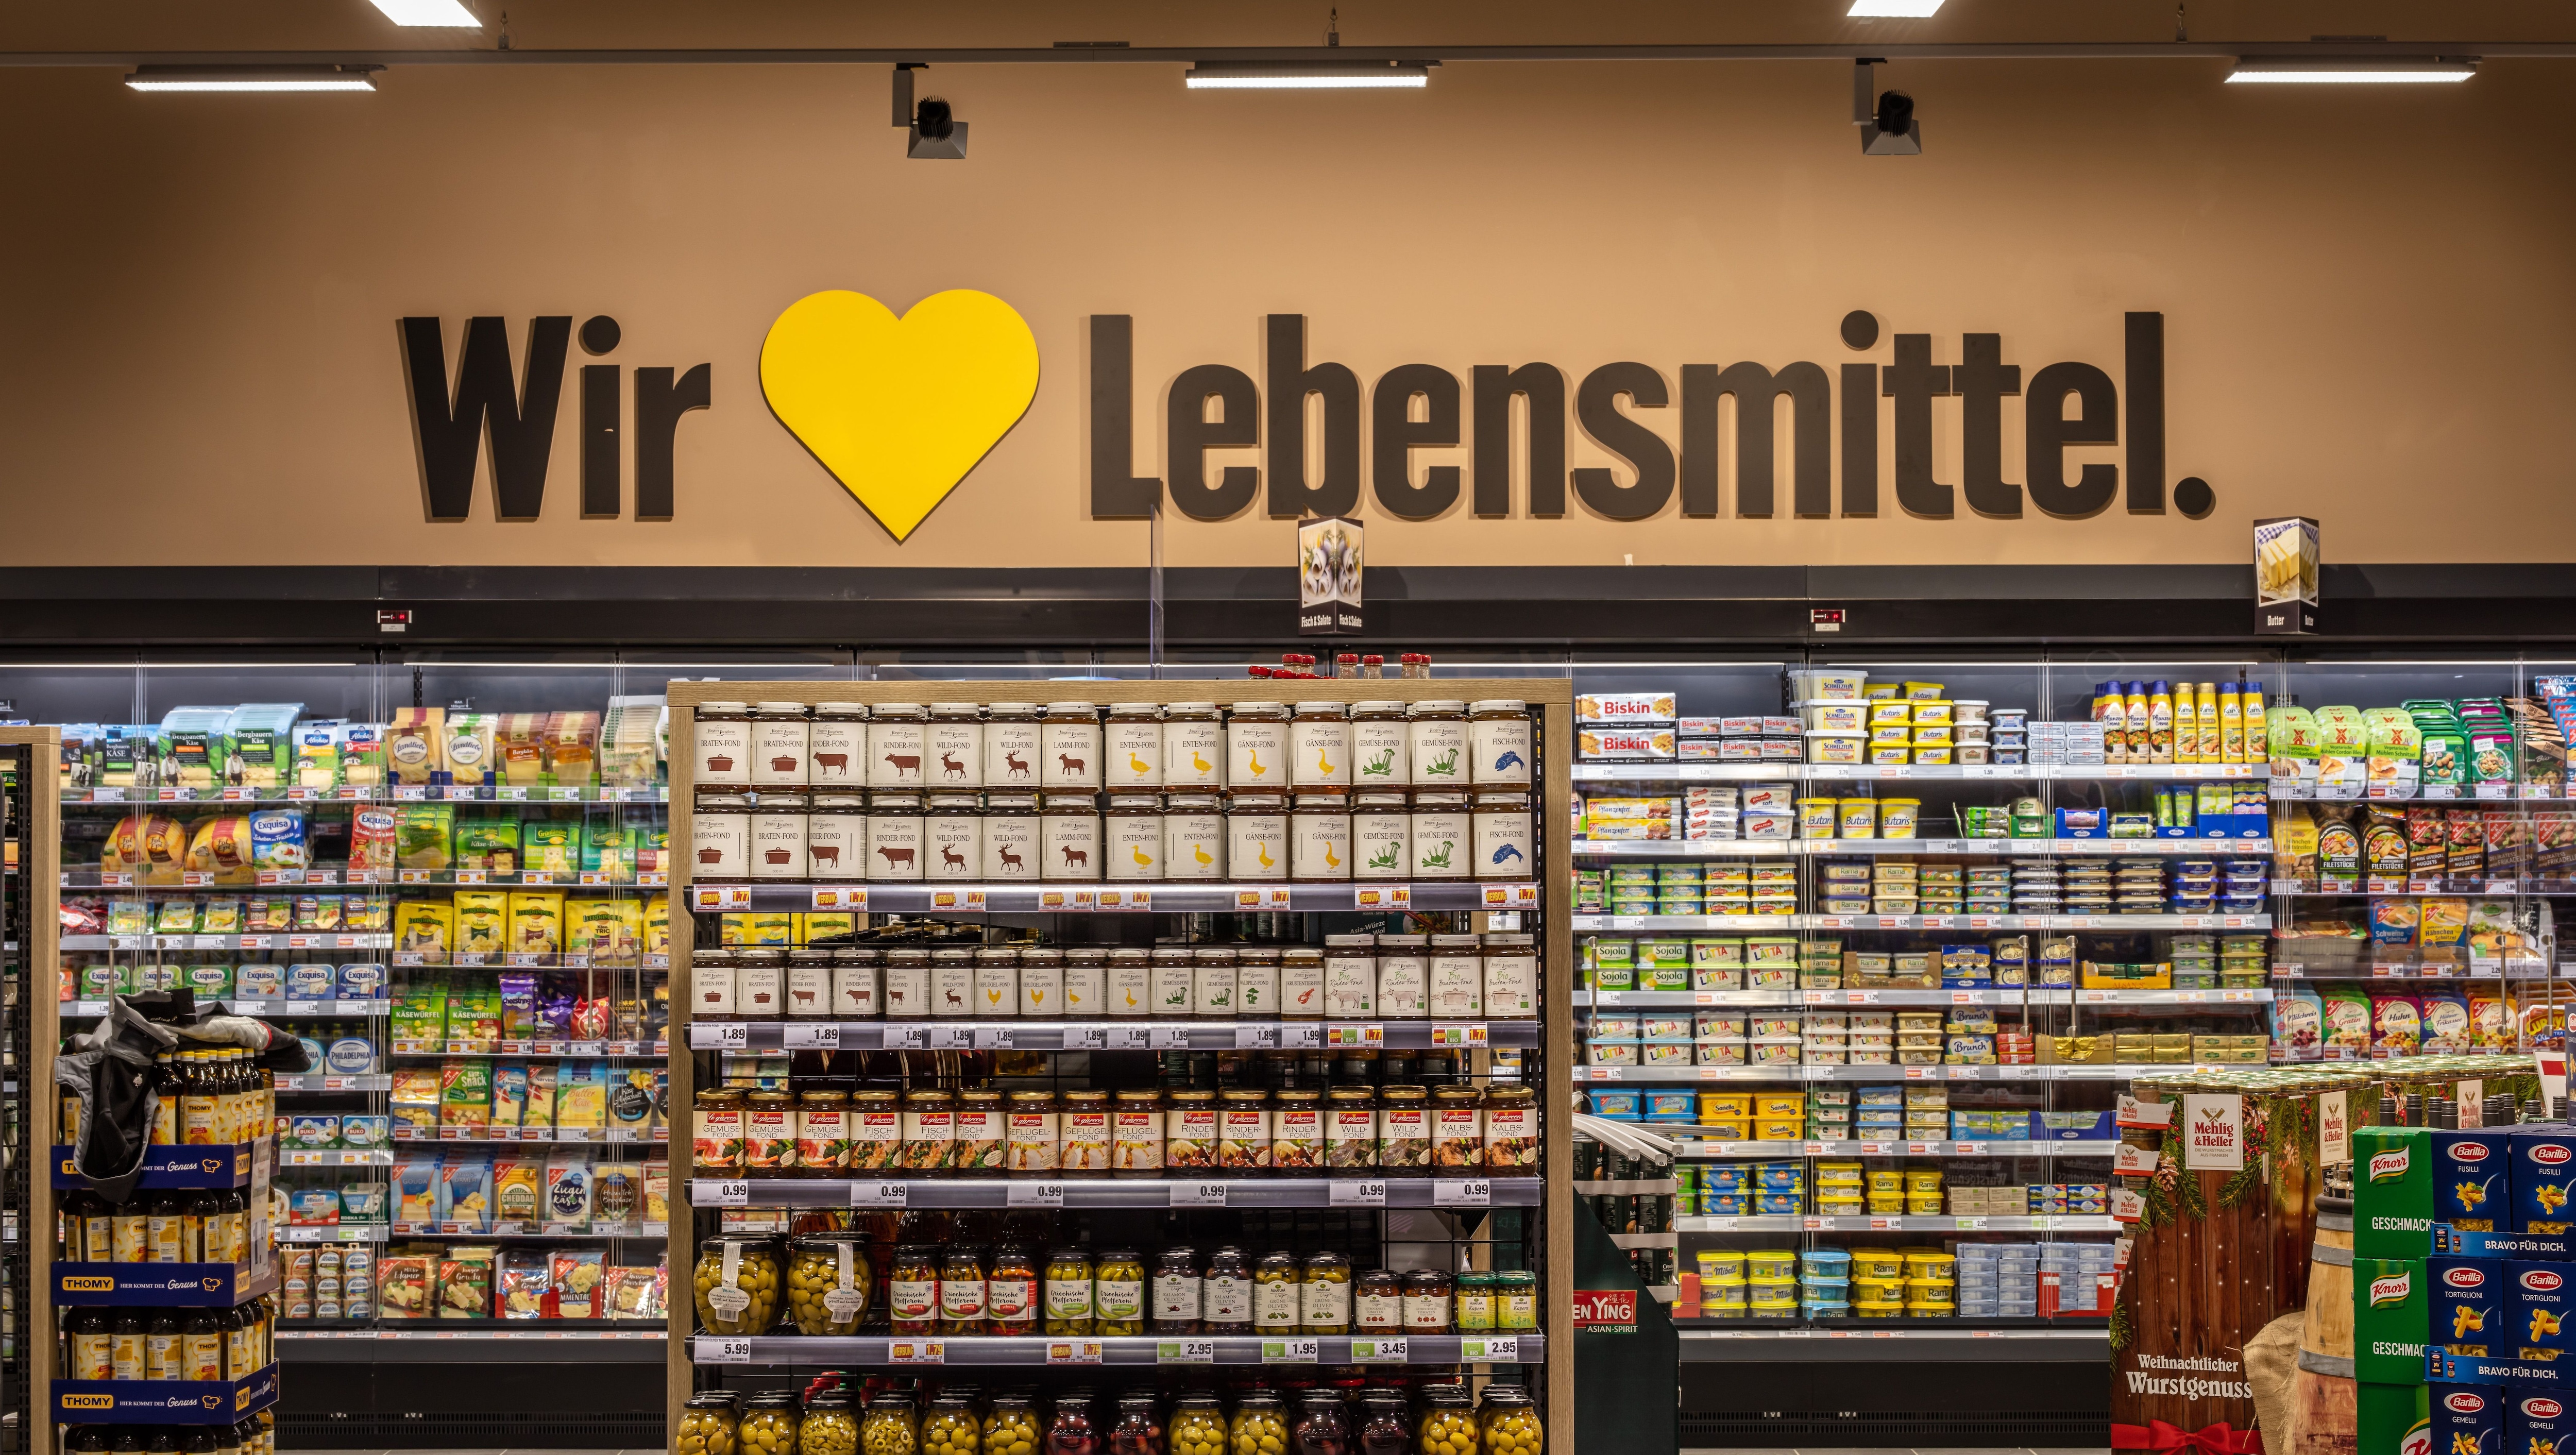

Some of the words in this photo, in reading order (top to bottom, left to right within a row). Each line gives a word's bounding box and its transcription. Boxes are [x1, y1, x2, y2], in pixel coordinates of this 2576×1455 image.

[401, 316, 714, 524] Wir
[1089, 311, 2215, 520] Lebensmittel.
[1301, 616, 1312, 627] Fisch
[1313, 616, 1317, 627] &
[1318, 615, 1331, 626] Salate
[1340, 614, 1348, 626] Fisch
[1348, 616, 1351, 627] &
[1352, 616, 1362, 627] Salate
[2268, 615, 2284, 626] Butter
[1604, 701, 1650, 714] Biskin
[1881, 708, 1900, 717] Butaris
[395, 742, 426, 753] Landliebe
[1238, 740, 1275, 748] GÄNSE-FOND
[1604, 737, 1650, 750] Biskin
[1599, 805, 1630, 814] Pflanzenfett
[258, 820, 289, 830] Exquisa
[1846, 816, 1872, 825] Butaris
[700, 893, 721, 903] WERBUNG
[734, 891, 749, 902] 1.77
[1359, 893, 1381, 902] WERBUNG
[1392, 890, 1409, 901] 1.77
[1600, 946, 1626, 956] Sojola
[297, 970, 325, 979] Exquisa
[1338, 972, 1350, 980] Bio
[1497, 971, 1509, 980] Bio
[396, 1010, 439, 1019] KÄSEWÜRFEL
[2388, 1012, 2411, 1023] Huhn
[2436, 1017, 2463, 1027] Frikassee
[721, 1028, 746, 1039] 1.89
[815, 1028, 838, 1040] 1.89
[906, 1031, 922, 1041] 1.89
[1303, 1030, 1319, 1041] 1.99
[1954, 1041, 1987, 1052] Brunch
[332, 1051, 370, 1060] PHILADELPHIA
[1597, 1046, 1624, 1061] LÄTTA
[703, 1124, 741, 1134] GEMÜSE-
[865, 1126, 893, 1135] FISCH-
[1065, 1126, 1110, 1136] GEFLÜGEL-
[1282, 1125, 1317, 1133] RINDER-
[1341, 1125, 1367, 1134] WILD-
[1492, 1124, 1524, 1132] KALBS-
[2195, 1122, 2233, 1137] Mehlig
[2457, 1147, 2485, 1156] Barilla
[2538, 1150, 2568, 1159] Barilla
[2371, 1156, 2407, 1173] Knorr
[722, 1185, 747, 1195] 0.99
[882, 1186, 905, 1197] 0.99
[1038, 1186, 1062, 1197] 0.99
[1200, 1185, 1225, 1196] 0.99
[1360, 1185, 1384, 1195] 0.99
[1465, 1183, 1488, 1195] 0.99
[501, 1194, 535, 1203] CHEDDAR
[2372, 1216, 2432, 1231] GESCHMACK
[2485, 1240, 2517, 1249] BRAVO
[2519, 1241, 2537, 1250] FÜR
[2540, 1242, 2566, 1251] DICH.
[1713, 1265, 1738, 1275] Mibell
[2452, 1273, 2481, 1281] Barilla
[2530, 1276, 2558, 1284] Barilla
[65, 1279, 111, 1288] THOMY
[167, 1280, 197, 1290] Genuss
[2374, 1282, 2408, 1297] Knorr
[1592, 1297, 1631, 1319] YING
[724, 1344, 749, 1355] 5.99
[893, 1345, 914, 1356] WERBUNG
[927, 1344, 943, 1355] 1.79
[1188, 1344, 1211, 1354] 2.95
[1293, 1344, 1316, 1354] 1.95
[1382, 1343, 1405, 1354] 3.45
[1492, 1342, 1516, 1352] 2.95
[2373, 1342, 2425, 1357] GESCHMAC
[2138, 1354, 2238, 1372] Weihnachtlicher
[2479, 1366, 2510, 1376] BRAVO
[2512, 1367, 2530, 1377] FÜR
[2533, 1369, 2558, 1379] DICH.
[2126, 1372, 2252, 1401] Wurstgenuss
[65, 1397, 110, 1406] THOMY
[167, 1398, 197, 1407] Genuss
[2453, 1398, 2481, 1407] Barilla
[2530, 1403, 2559, 1412] Barilla
